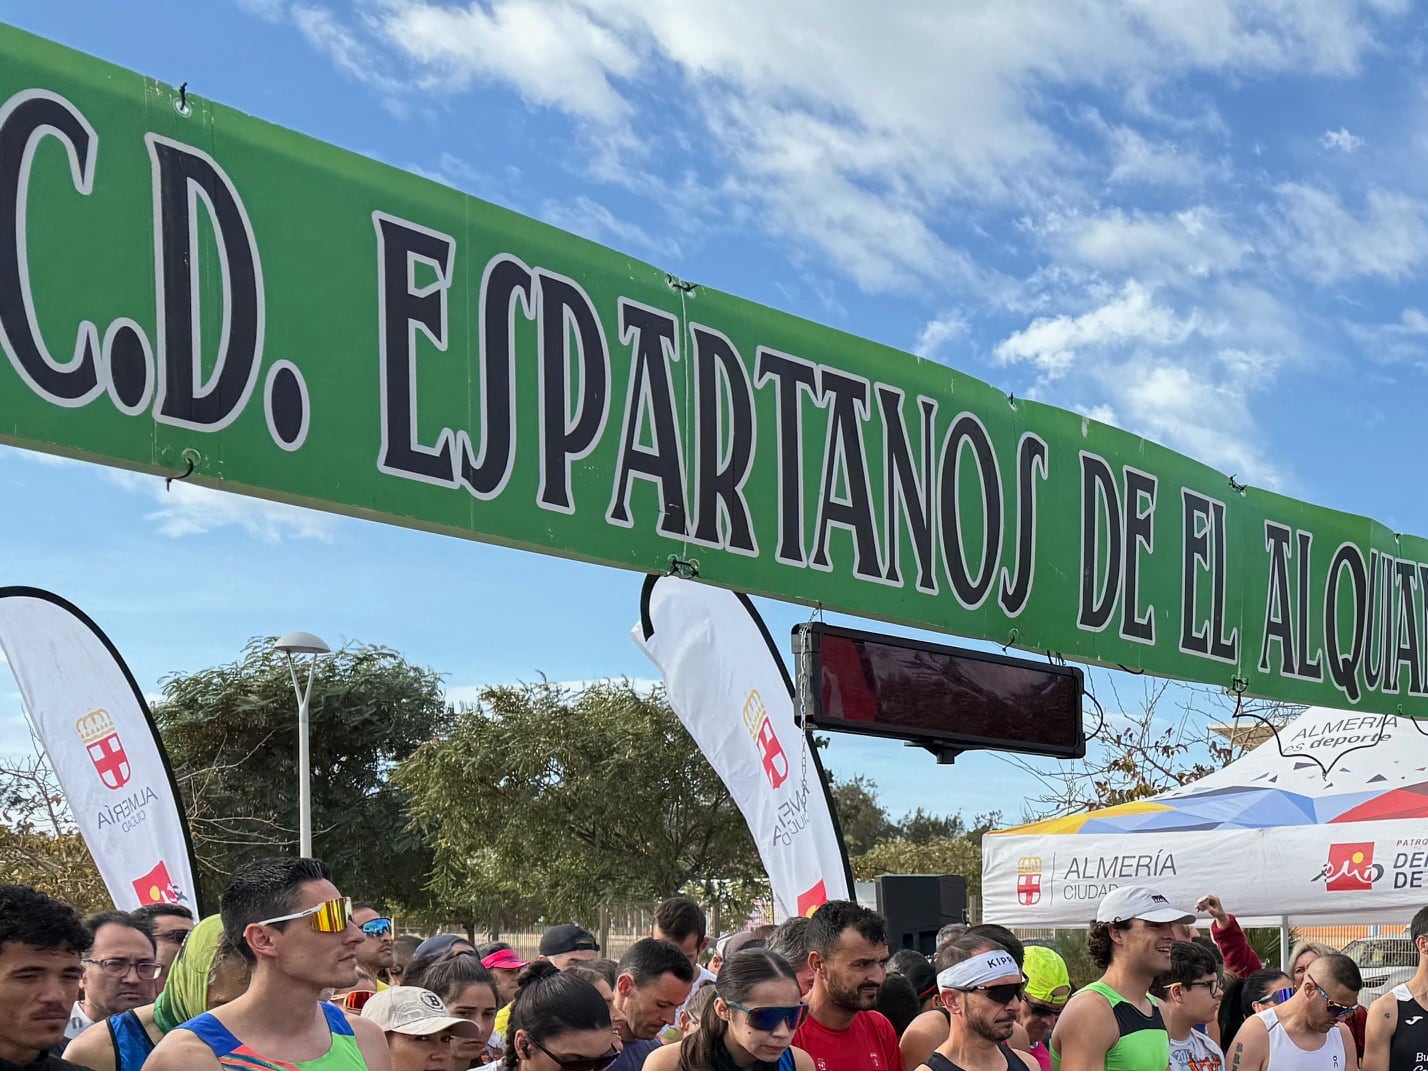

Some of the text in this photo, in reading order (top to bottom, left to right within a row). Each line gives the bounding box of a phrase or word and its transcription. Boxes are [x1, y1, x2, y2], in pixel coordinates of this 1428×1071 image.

[0, 88, 310, 451] C.D.
[372, 210, 1049, 618] ESPARTANOS
[1078, 450, 1158, 646] DE
[1180, 487, 1240, 665] EL
[1309, 732, 1392, 749] deporte
[1063, 848, 1177, 880] ALMERÍA
[1393, 871, 1424, 889] DE
